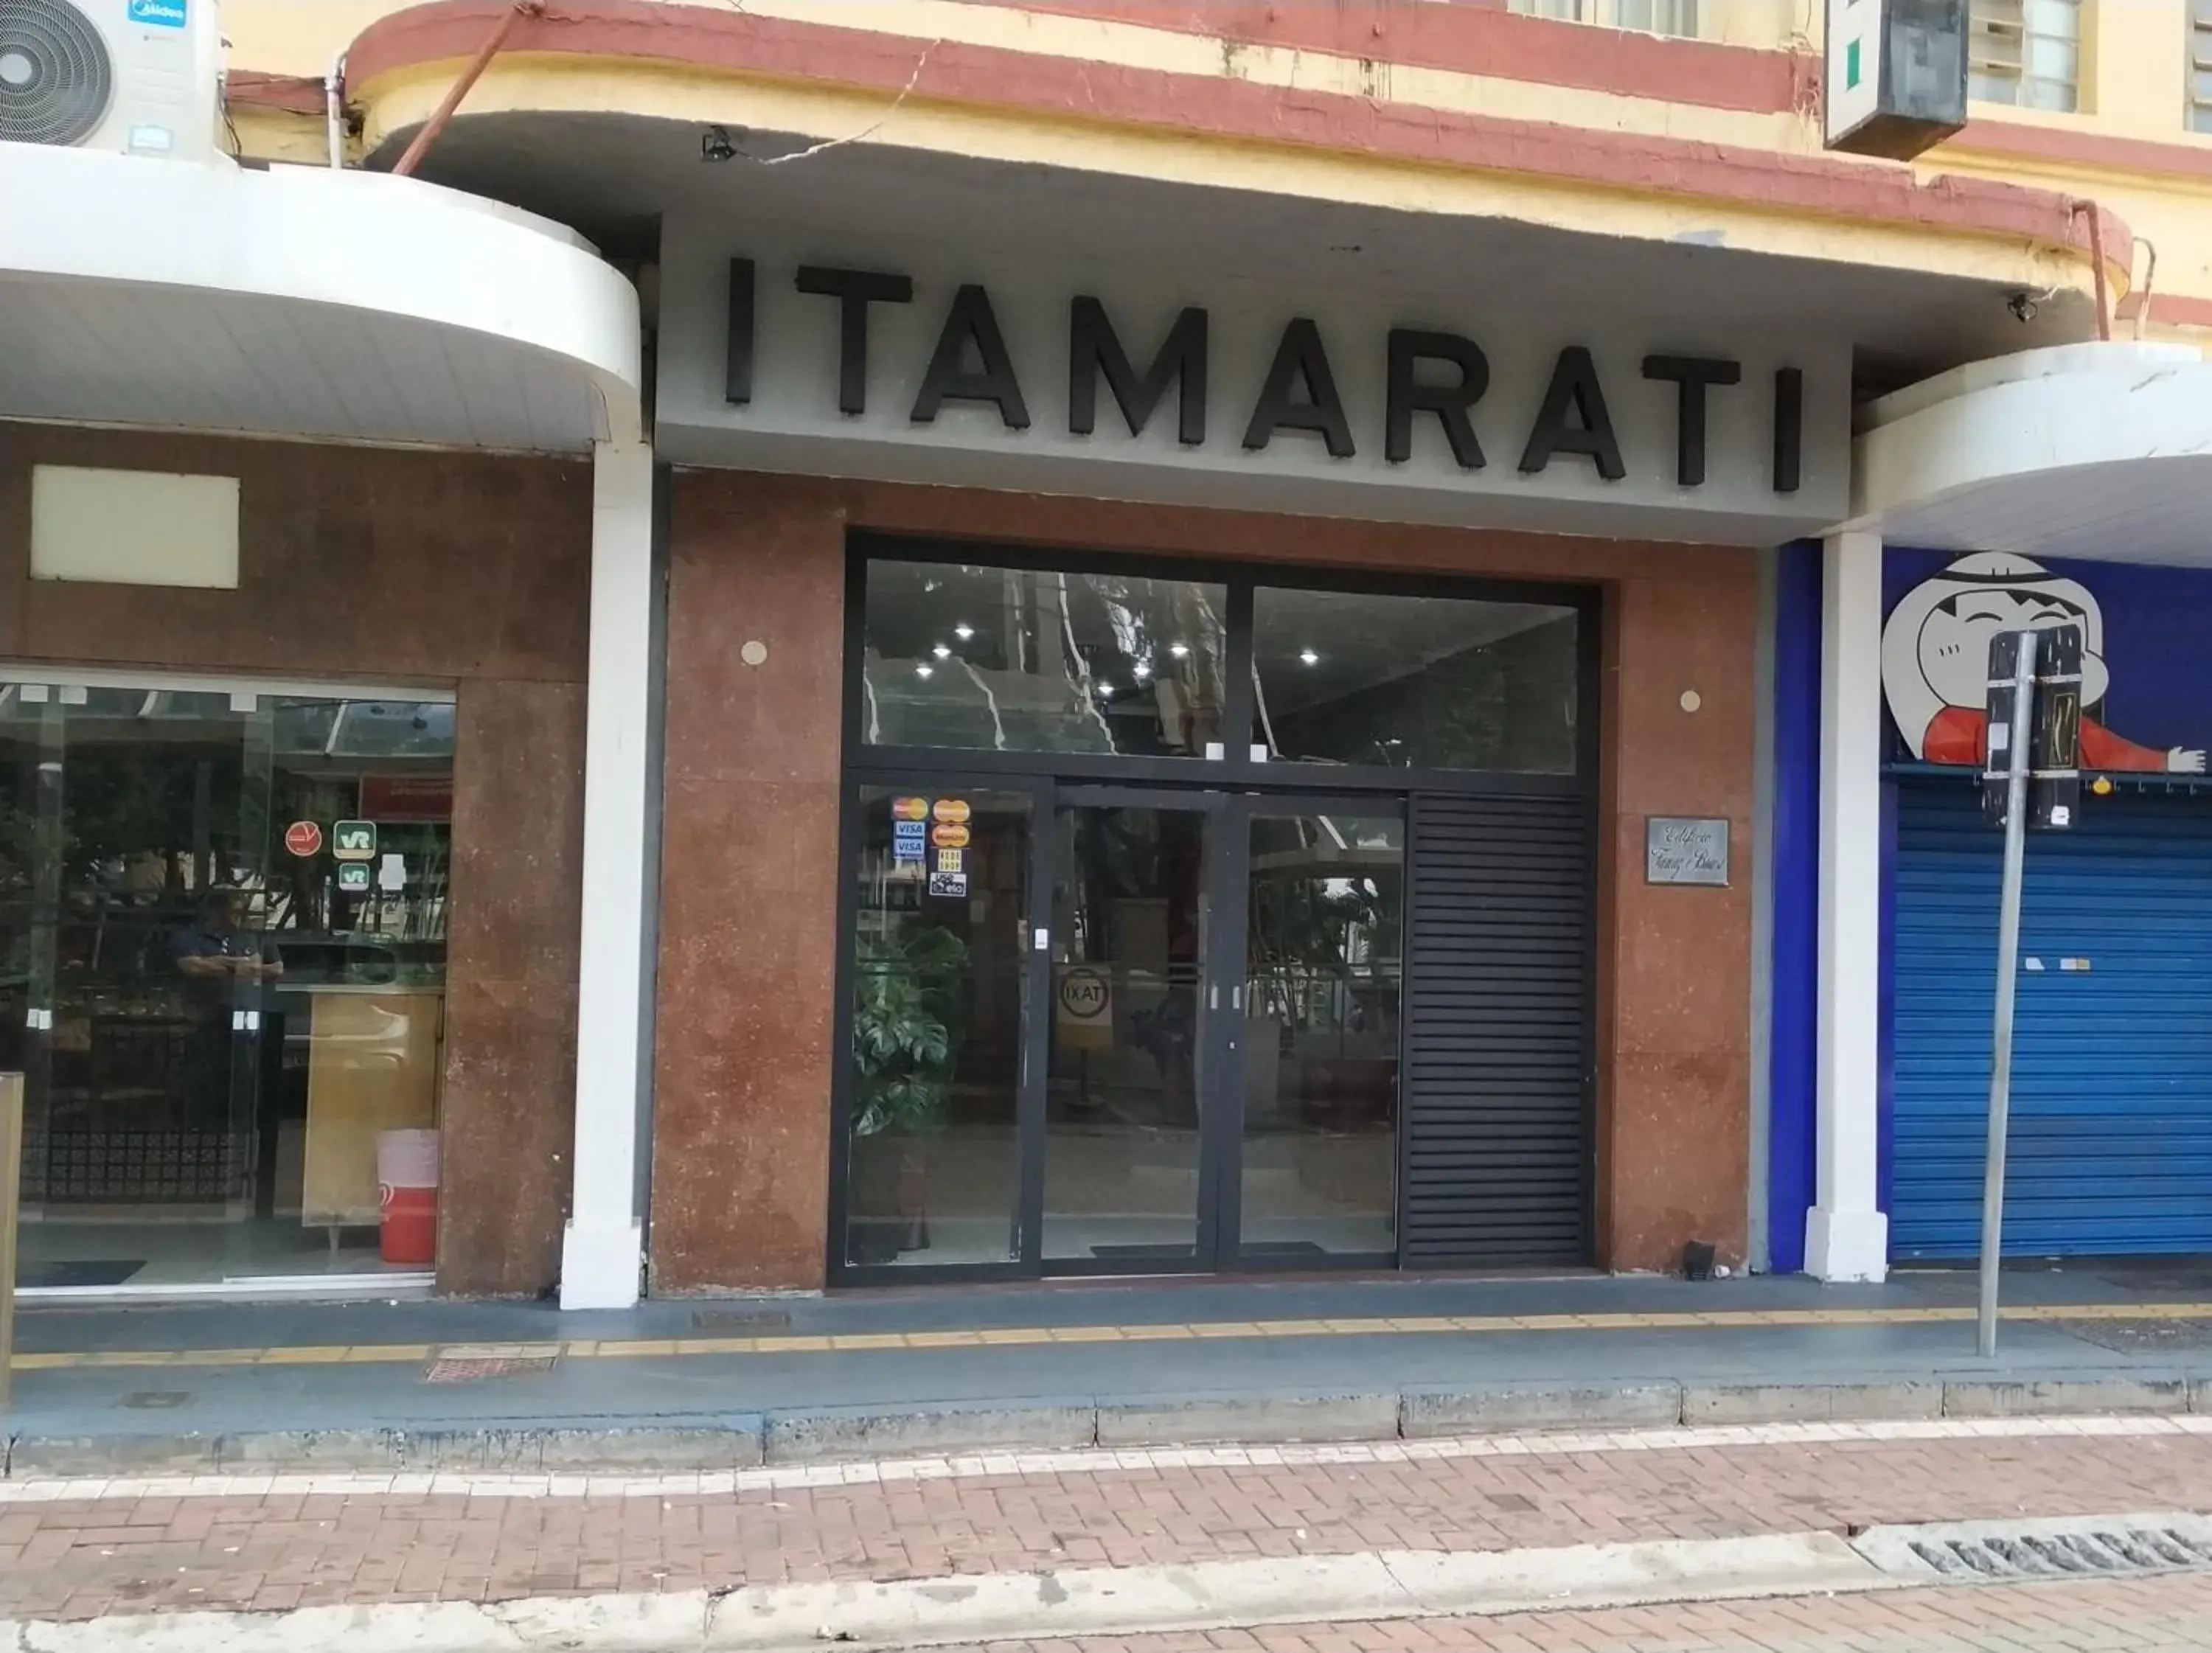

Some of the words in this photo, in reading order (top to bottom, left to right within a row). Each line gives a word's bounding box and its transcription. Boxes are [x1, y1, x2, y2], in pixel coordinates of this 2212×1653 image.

[142, 2, 184, 18] Midea
[726, 257, 1801, 492] ITAMARATI
[900, 824, 922, 833] VISA
[340, 831, 370, 849] VR
[898, 842, 922, 851] VISA
[343, 870, 366, 883] VR
